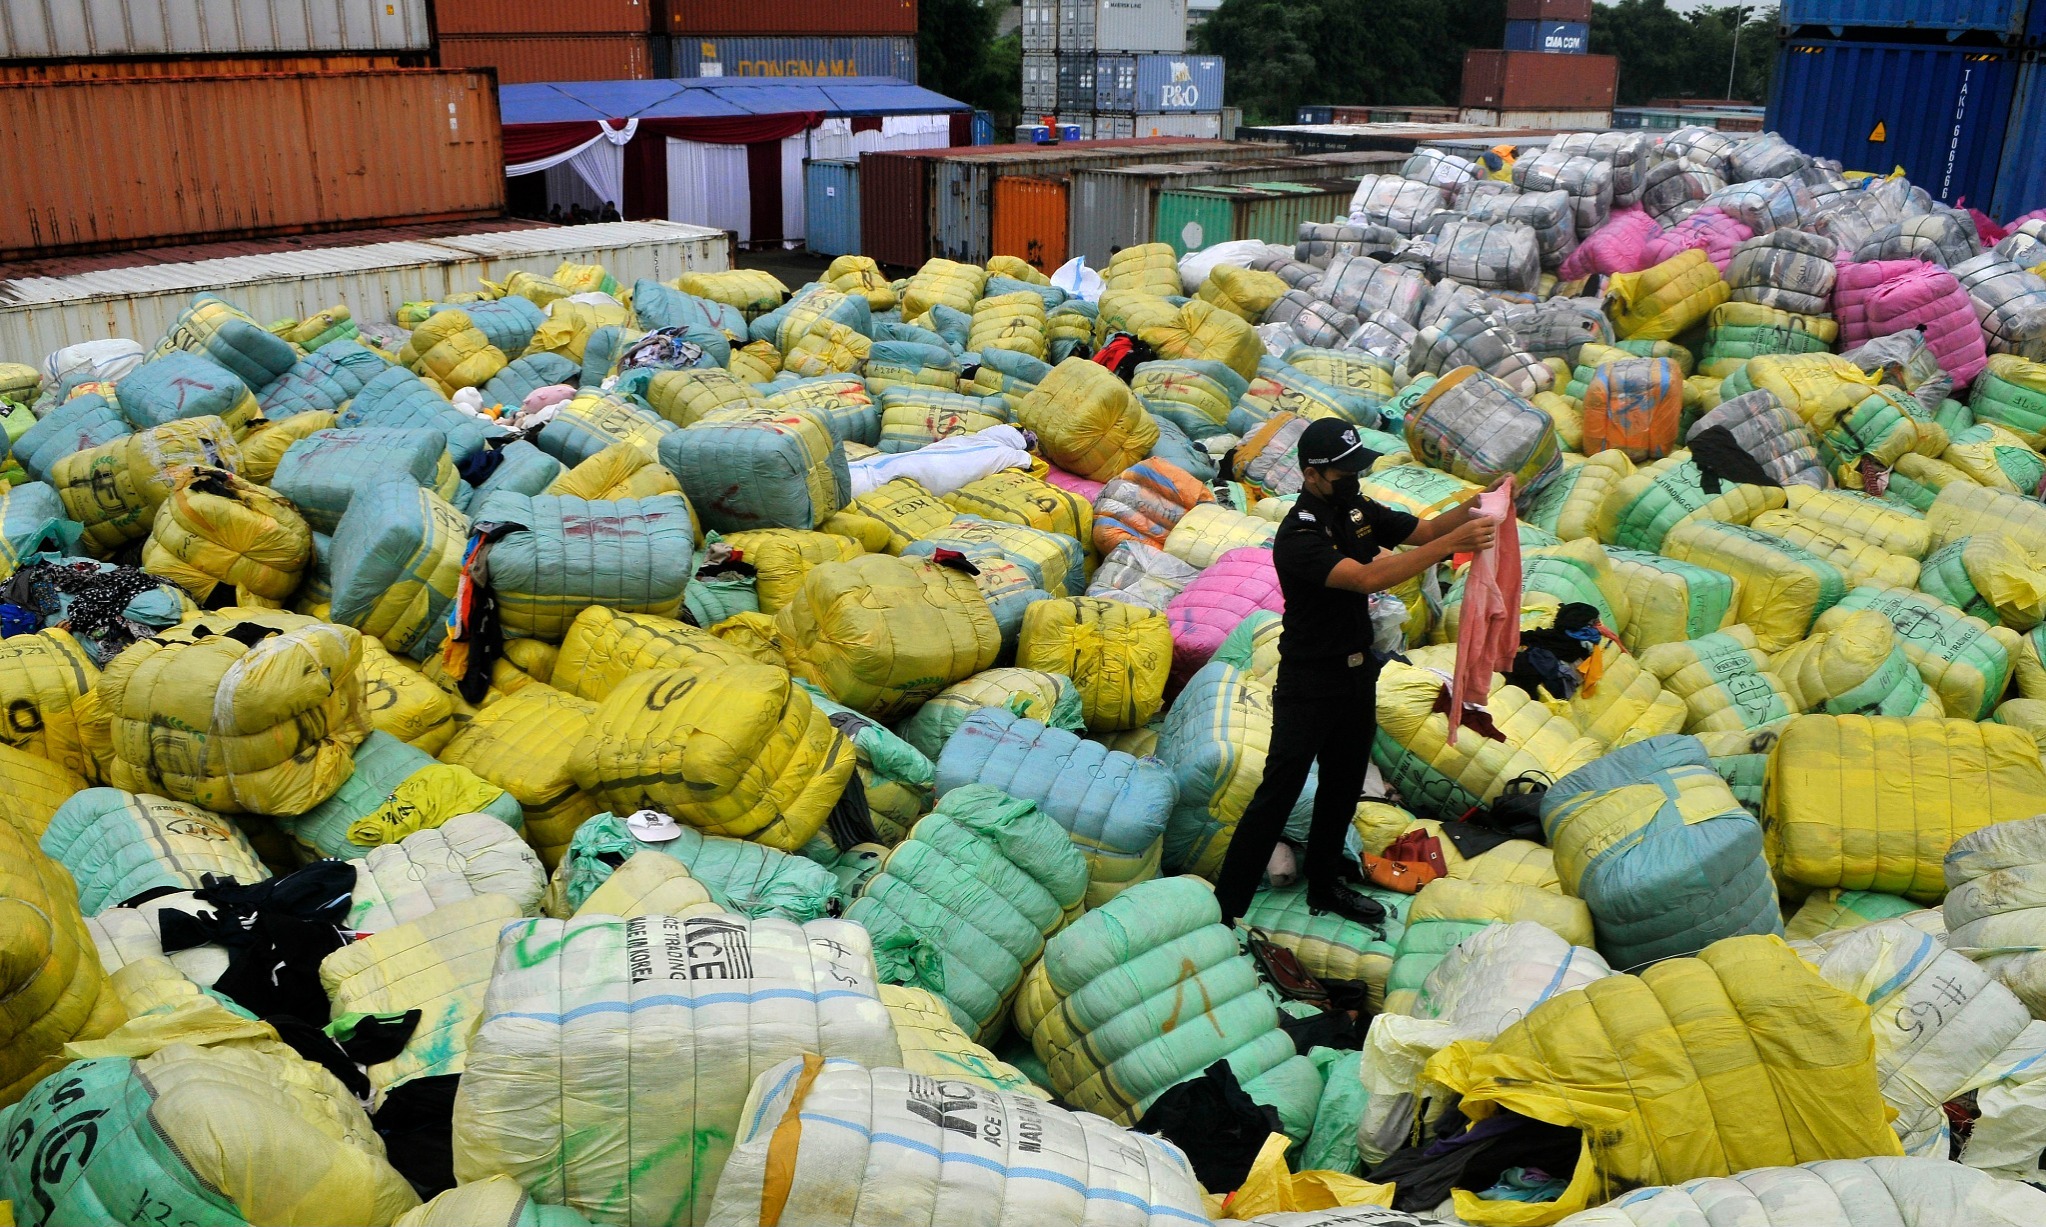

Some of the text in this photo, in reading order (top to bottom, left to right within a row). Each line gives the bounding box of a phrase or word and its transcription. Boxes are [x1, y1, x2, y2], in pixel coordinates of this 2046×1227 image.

[1545, 36, 1580, 48] CMA CGM
[738, 59, 857, 76] DONGNAMA
[1161, 85, 1198, 106] P&O
[1941, 69, 1971, 199] TAKU 606366
[1347, 363, 1371, 389] KS
[601, 412, 645, 440] KS
[937, 407, 969, 436] KS
[891, 498, 930, 518] KCT
[1716, 657, 1748, 671] PREMIUM
[626, 916, 653, 985] MADE IN KOREA
[664, 933, 687, 980] TRADING
[1895, 975, 1969, 1044] #65
[983, 1116, 1002, 1148] ACE
[1018, 1116, 1043, 1153] MADE
